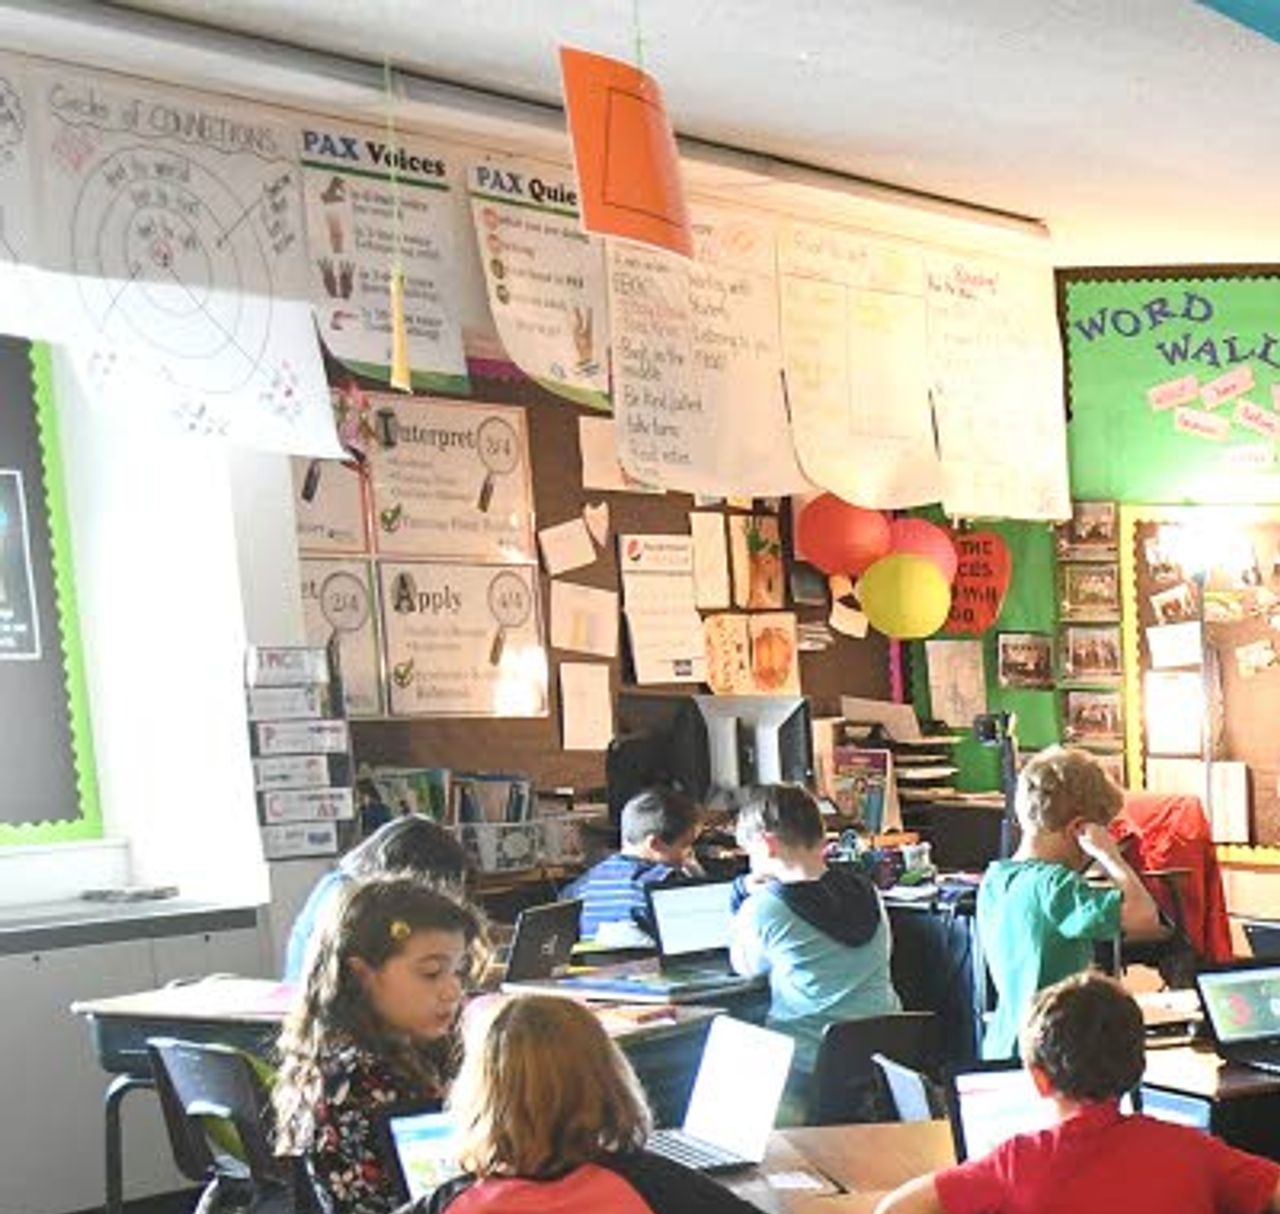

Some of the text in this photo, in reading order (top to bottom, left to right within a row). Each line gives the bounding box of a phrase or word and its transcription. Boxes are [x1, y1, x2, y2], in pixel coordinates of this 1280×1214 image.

[303, 131, 447, 177] PAX Voices
[476, 166, 524, 195] PAX
[1074, 291, 1213, 342] WORD
[377, 407, 477, 451] Interpret
[393, 571, 463, 615] Apply
